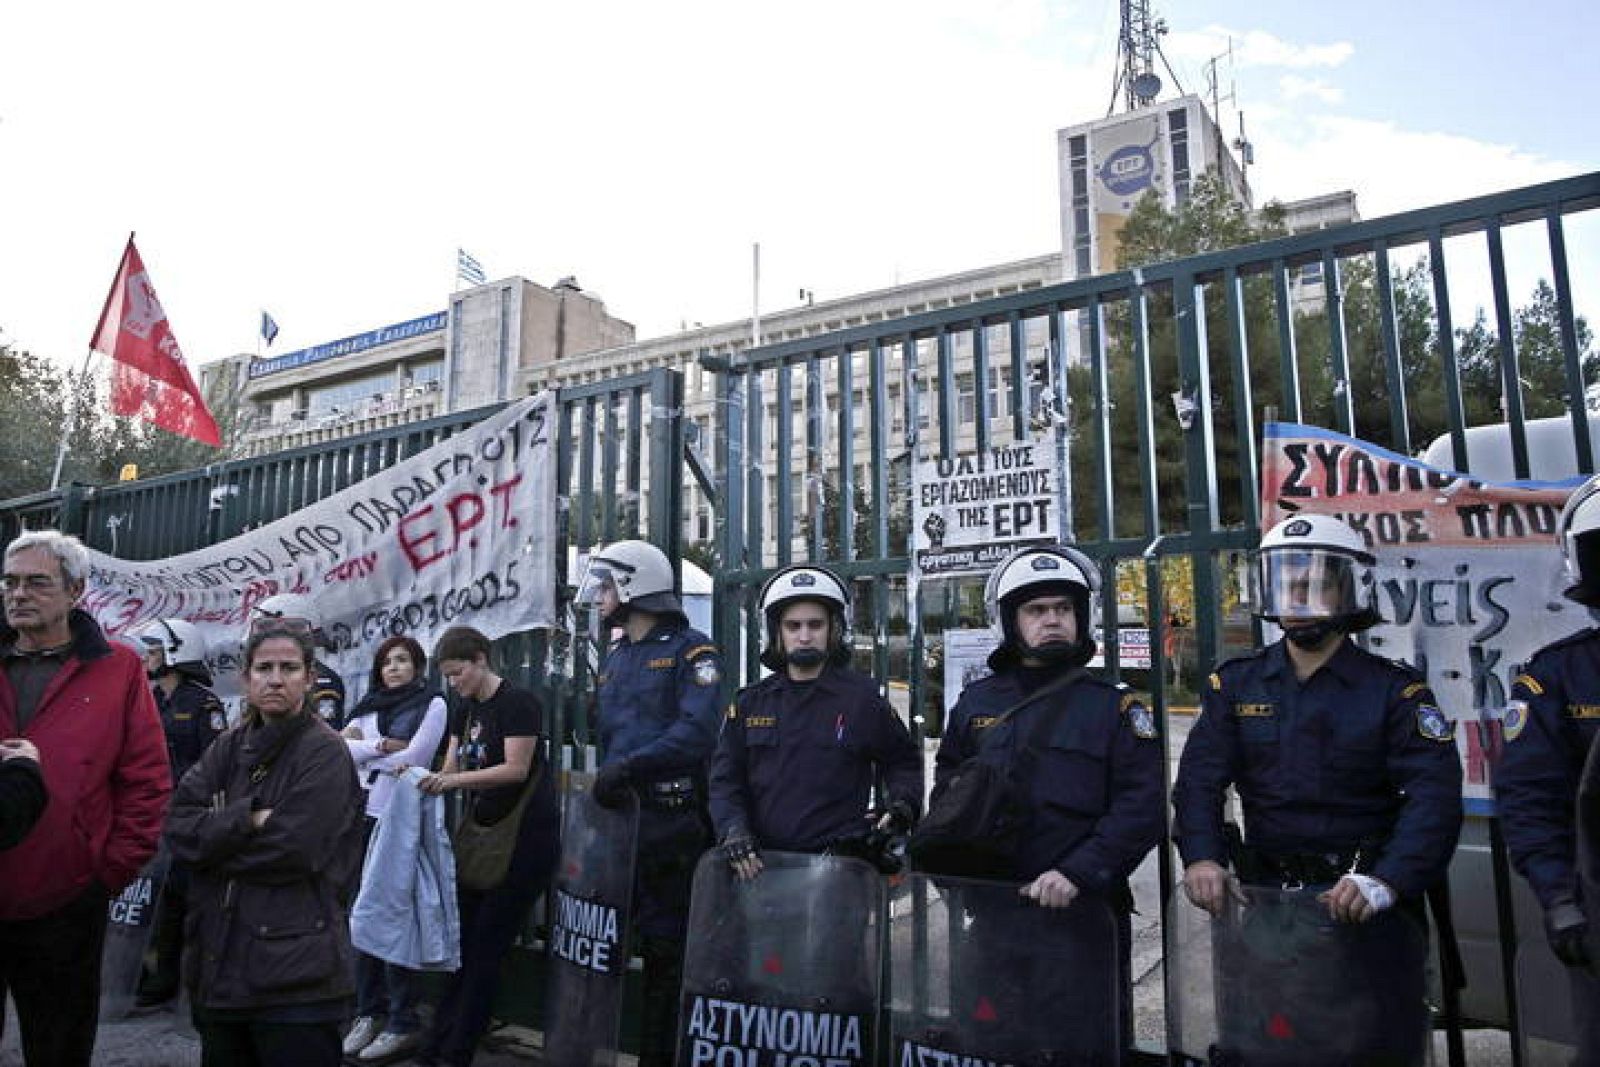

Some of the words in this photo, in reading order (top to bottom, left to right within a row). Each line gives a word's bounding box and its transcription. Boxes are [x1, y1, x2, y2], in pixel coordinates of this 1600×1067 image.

[992, 446, 1034, 470] ΤΟΥΣ
[921, 468, 1052, 507] ΕΡΓΑΖΟΜΕΝΟΥΣ
[957, 506, 989, 528] ΤΗΣ
[993, 498, 1051, 537] ΕΡΤ
[687, 995, 862, 1059] ΑΣΤΥΝΟΜΙΑ
